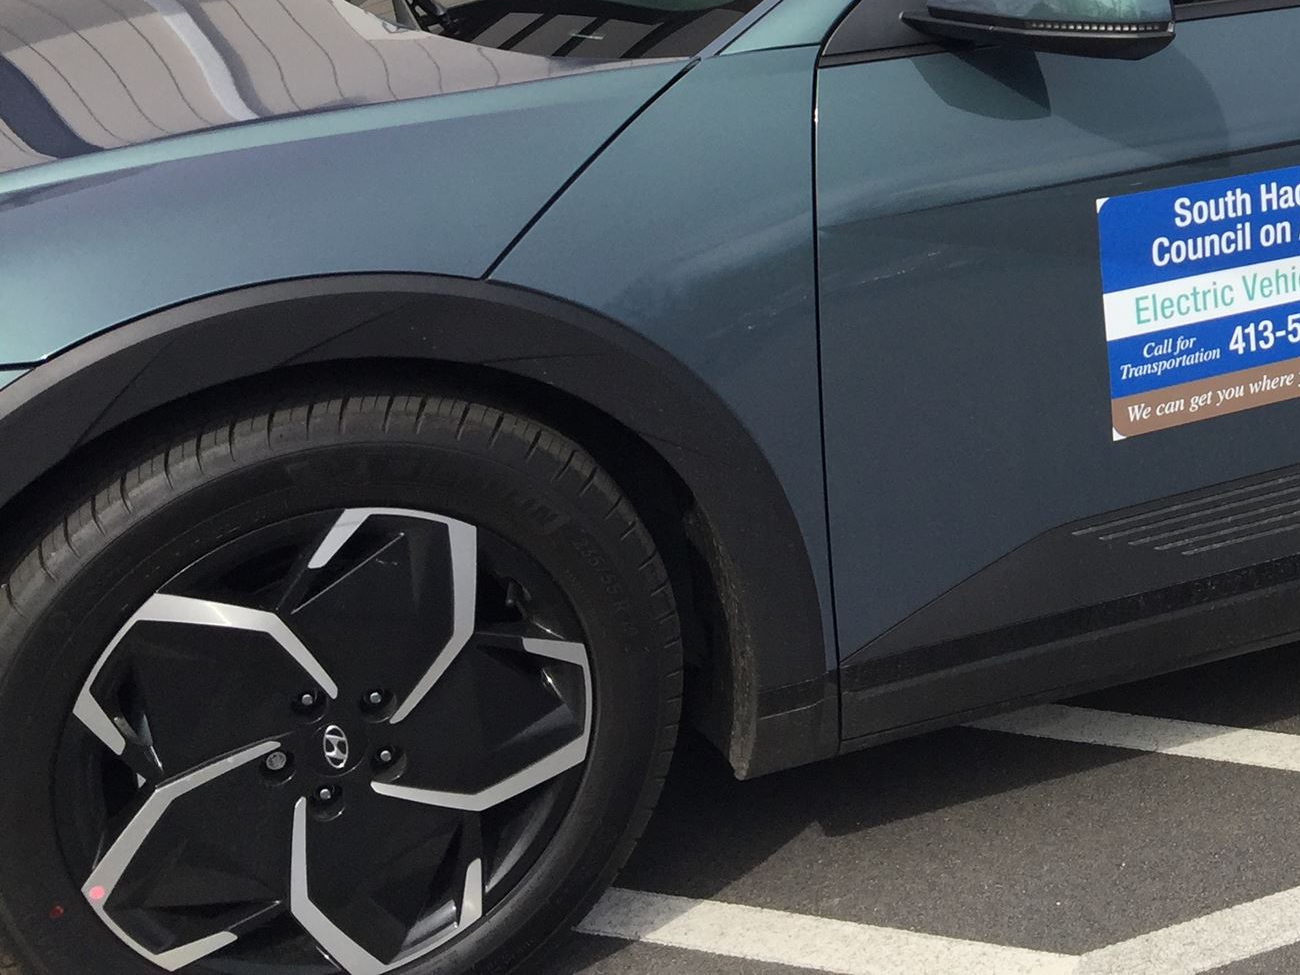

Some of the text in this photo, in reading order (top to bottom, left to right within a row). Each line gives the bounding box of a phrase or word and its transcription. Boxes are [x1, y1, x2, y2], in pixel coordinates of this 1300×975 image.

[1174, 188, 1251, 228] South
[1152, 222, 1251, 267] Council
[1260, 224, 1291, 248] on
[1135, 284, 1234, 325] Electric
[1120, 347, 1221, 380] Transportation
[1143, 336, 1196, 359] Call for
[1127, 403, 1151, 423] We
[1156, 399, 1184, 417] can
[1189, 392, 1213, 413] get
[1216, 385, 1245, 407] you
[1249, 371, 1295, 394] where
